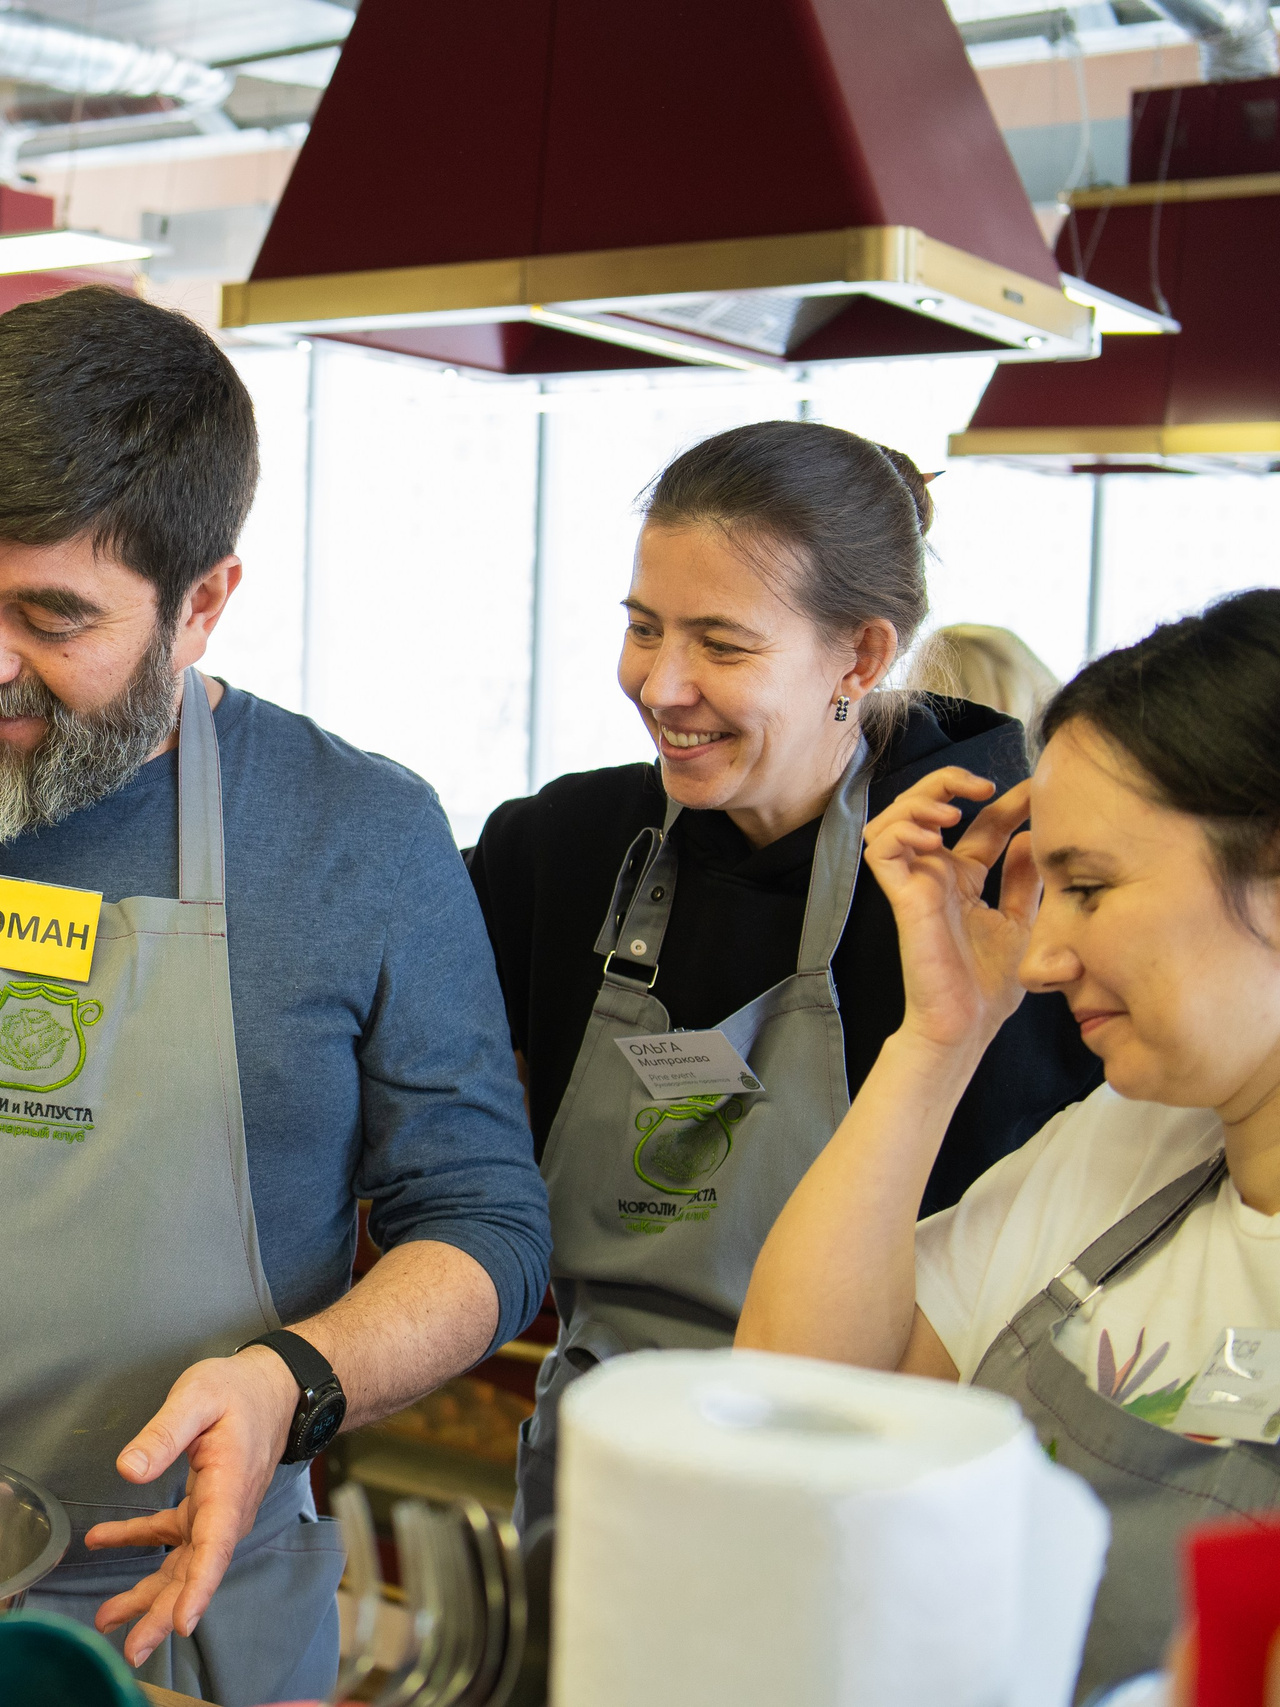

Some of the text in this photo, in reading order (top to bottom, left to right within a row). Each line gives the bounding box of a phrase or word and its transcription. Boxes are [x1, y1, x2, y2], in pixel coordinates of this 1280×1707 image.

[629, 1041, 682, 1056] ОЛЬГА
[637, 1055, 711, 1067] Митракова
[648, 1071, 697, 1082] Pine event
[11, 1102, 20, 1114] и
[23, 1101, 94, 1122] КАПУСТА
[52, 1129, 86, 1145] клуб
[618, 1199, 677, 1217] КОРОЛИ
